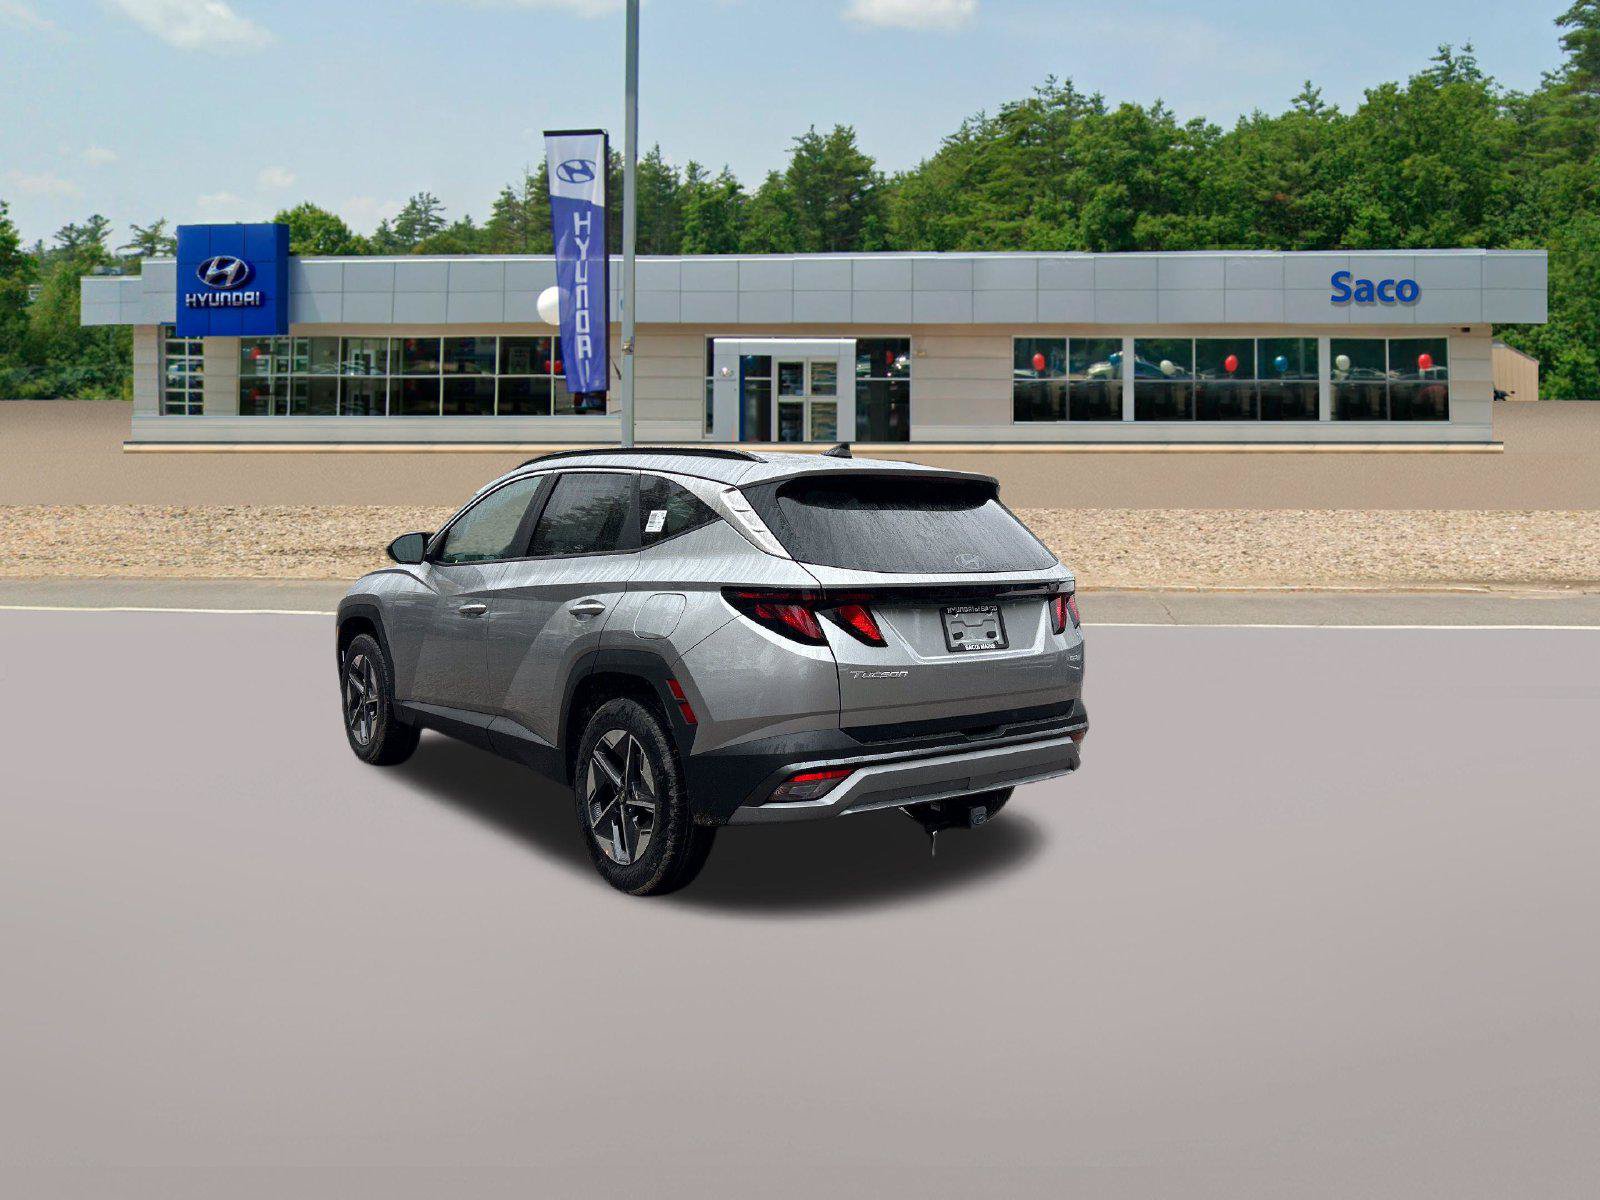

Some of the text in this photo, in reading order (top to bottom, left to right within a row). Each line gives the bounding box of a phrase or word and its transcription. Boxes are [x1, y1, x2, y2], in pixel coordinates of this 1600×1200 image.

[185, 291, 260, 306] HYUNDAI
[573, 211, 592, 383] HYUNDAI
[1330, 270, 1419, 302] Saco
